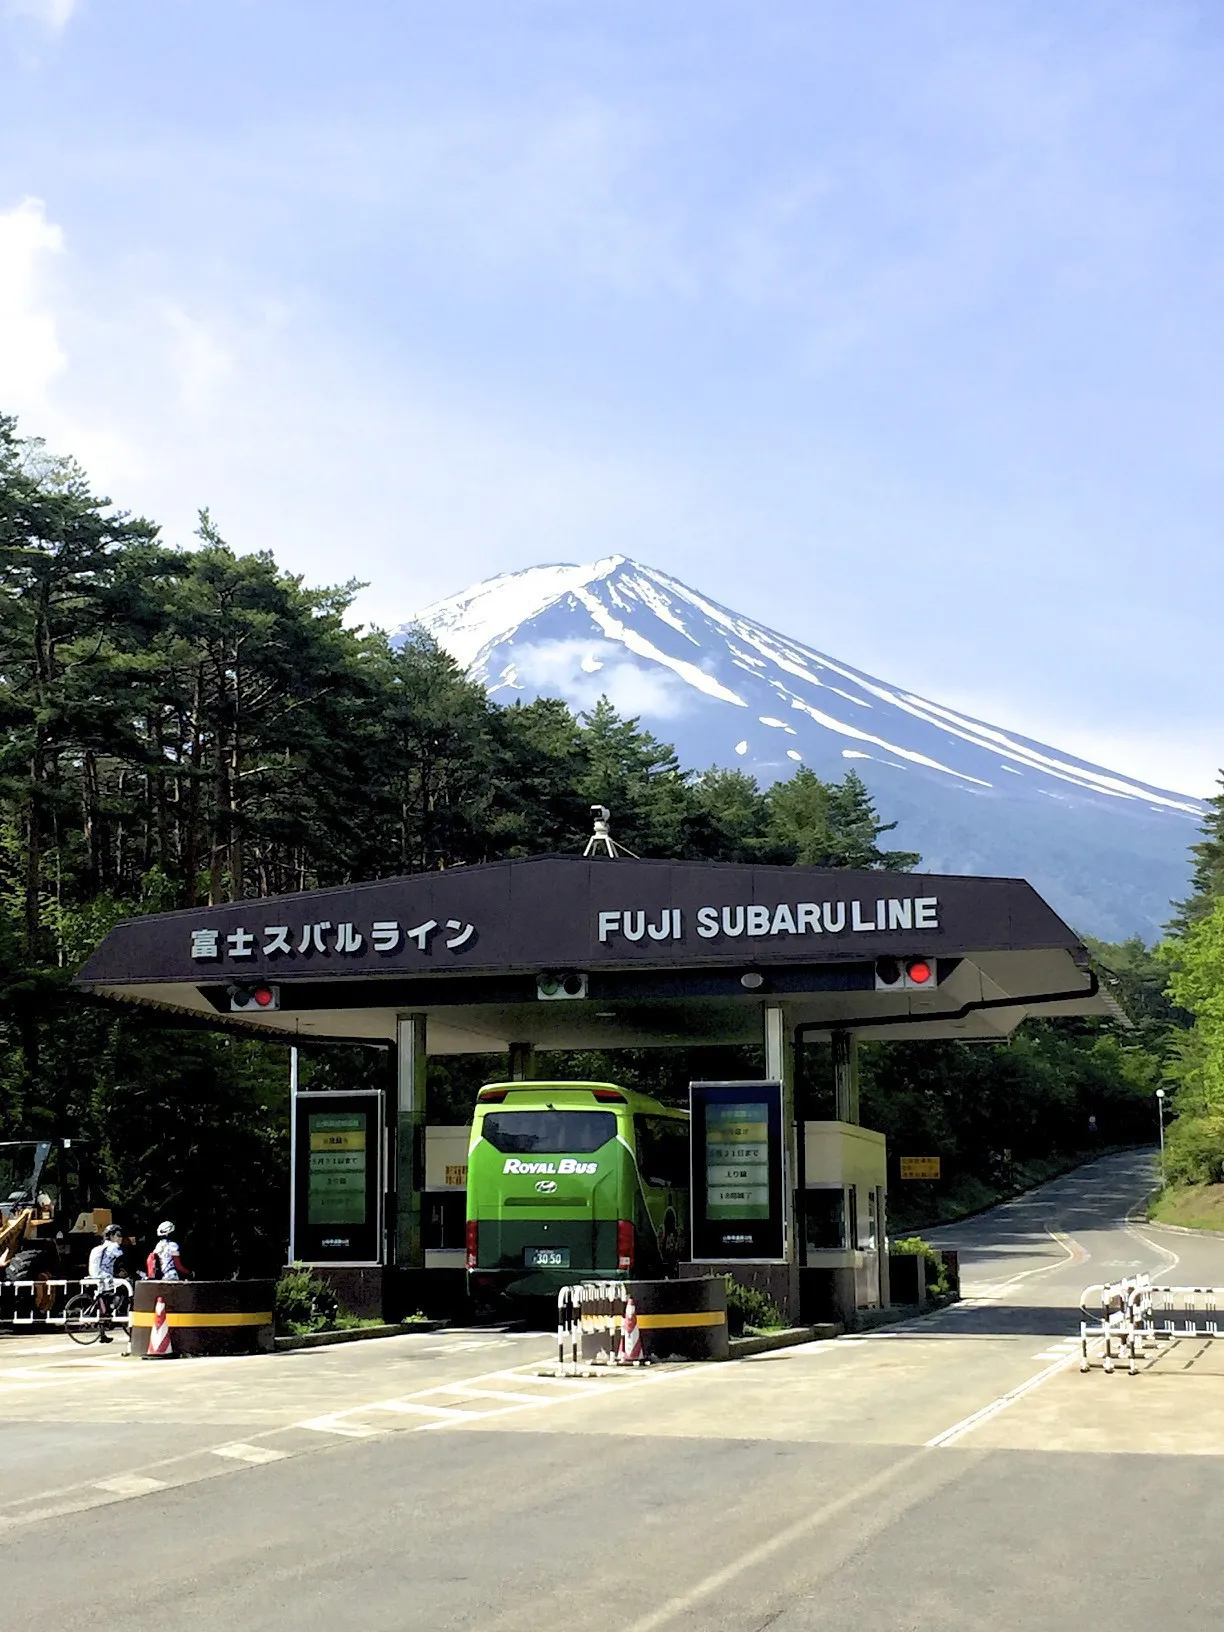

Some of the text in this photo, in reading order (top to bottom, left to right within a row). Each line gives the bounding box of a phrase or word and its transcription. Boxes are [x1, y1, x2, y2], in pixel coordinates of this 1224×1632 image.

[191, 919, 475, 959] 富士スバルライン
[598, 909, 682, 942] FUJI
